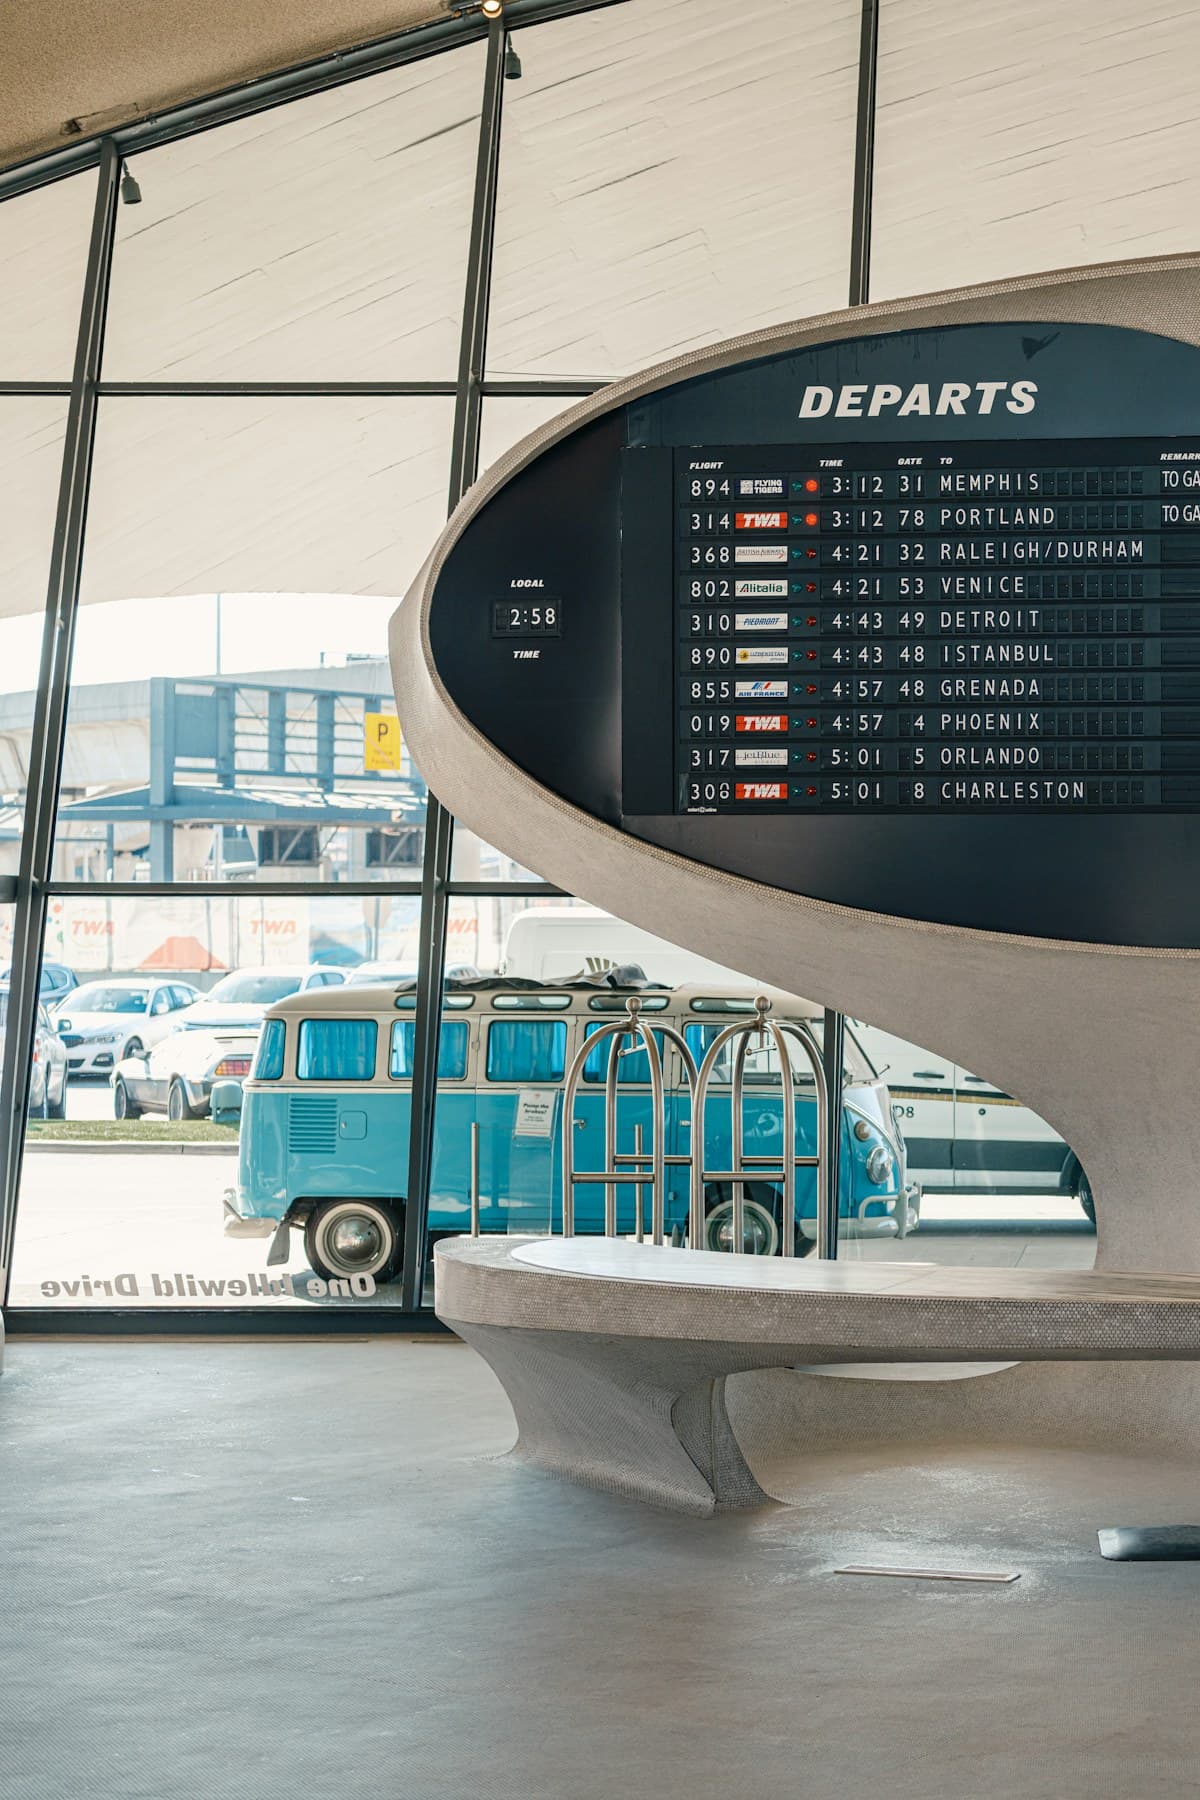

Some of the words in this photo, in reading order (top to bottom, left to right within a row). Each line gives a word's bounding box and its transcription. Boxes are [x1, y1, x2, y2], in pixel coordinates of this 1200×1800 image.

[798, 381, 1038, 418] DEPARTS
[692, 480, 729, 496] 894
[833, 477, 883, 493] 3:12
[901, 476, 921, 491] 31
[941, 474, 1038, 491] MEMPHIS
[1162, 471, 1178, 487] TO
[692, 514, 729, 529] 314
[833, 511, 883, 527] 3:12
[900, 510, 924, 526] 78
[942, 508, 1054, 525] PORTLAND
[1162, 505, 1179, 521] TO
[744, 513, 780, 527] TWA
[692, 547, 729, 563] 368
[832, 545, 879, 561] 4:21
[901, 544, 924, 560] 32
[941, 541, 1142, 559] RALEIGH/DURHAM
[692, 581, 729, 597] 802
[833, 579, 879, 595] 4:21
[900, 578, 923, 594] 53
[942, 577, 1023, 593] VENICE
[739, 583, 782, 592] Alitalia
[511, 608, 555, 625] 2:58
[692, 615, 729, 631] 310
[833, 613, 882, 628] 4:43
[900, 612, 924, 628] 49
[941, 611, 1038, 627] DETROIT
[692, 648, 730, 664] 890
[833, 647, 882, 663] 4:43
[900, 646, 924, 662] 48
[945, 645, 1053, 662] ISTANBUL
[692, 682, 729, 698] 855
[833, 681, 882, 696] 4:57
[900, 680, 924, 696] 48
[941, 680, 1038, 696] GRENADA
[692, 716, 729, 731] 019
[833, 715, 882, 730] 4:57
[914, 715, 924, 730] 4
[942, 713, 1038, 730] PHOENIX
[744, 716, 780, 730] TWA
[378, 723, 388, 744] P
[692, 750, 729, 766] 317
[832, 749, 879, 764] 5:01
[915, 748, 923, 764] 5
[941, 748, 1039, 764] ORLANDO
[744, 784, 780, 798] TWA
[832, 783, 879, 799] 5:01
[915, 783, 924, 798] 8
[942, 782, 1083, 798] CHARLESTON
[72, 921, 116, 936] TWA
[249, 920, 296, 935] TWA
[448, 919, 479, 933] WA
